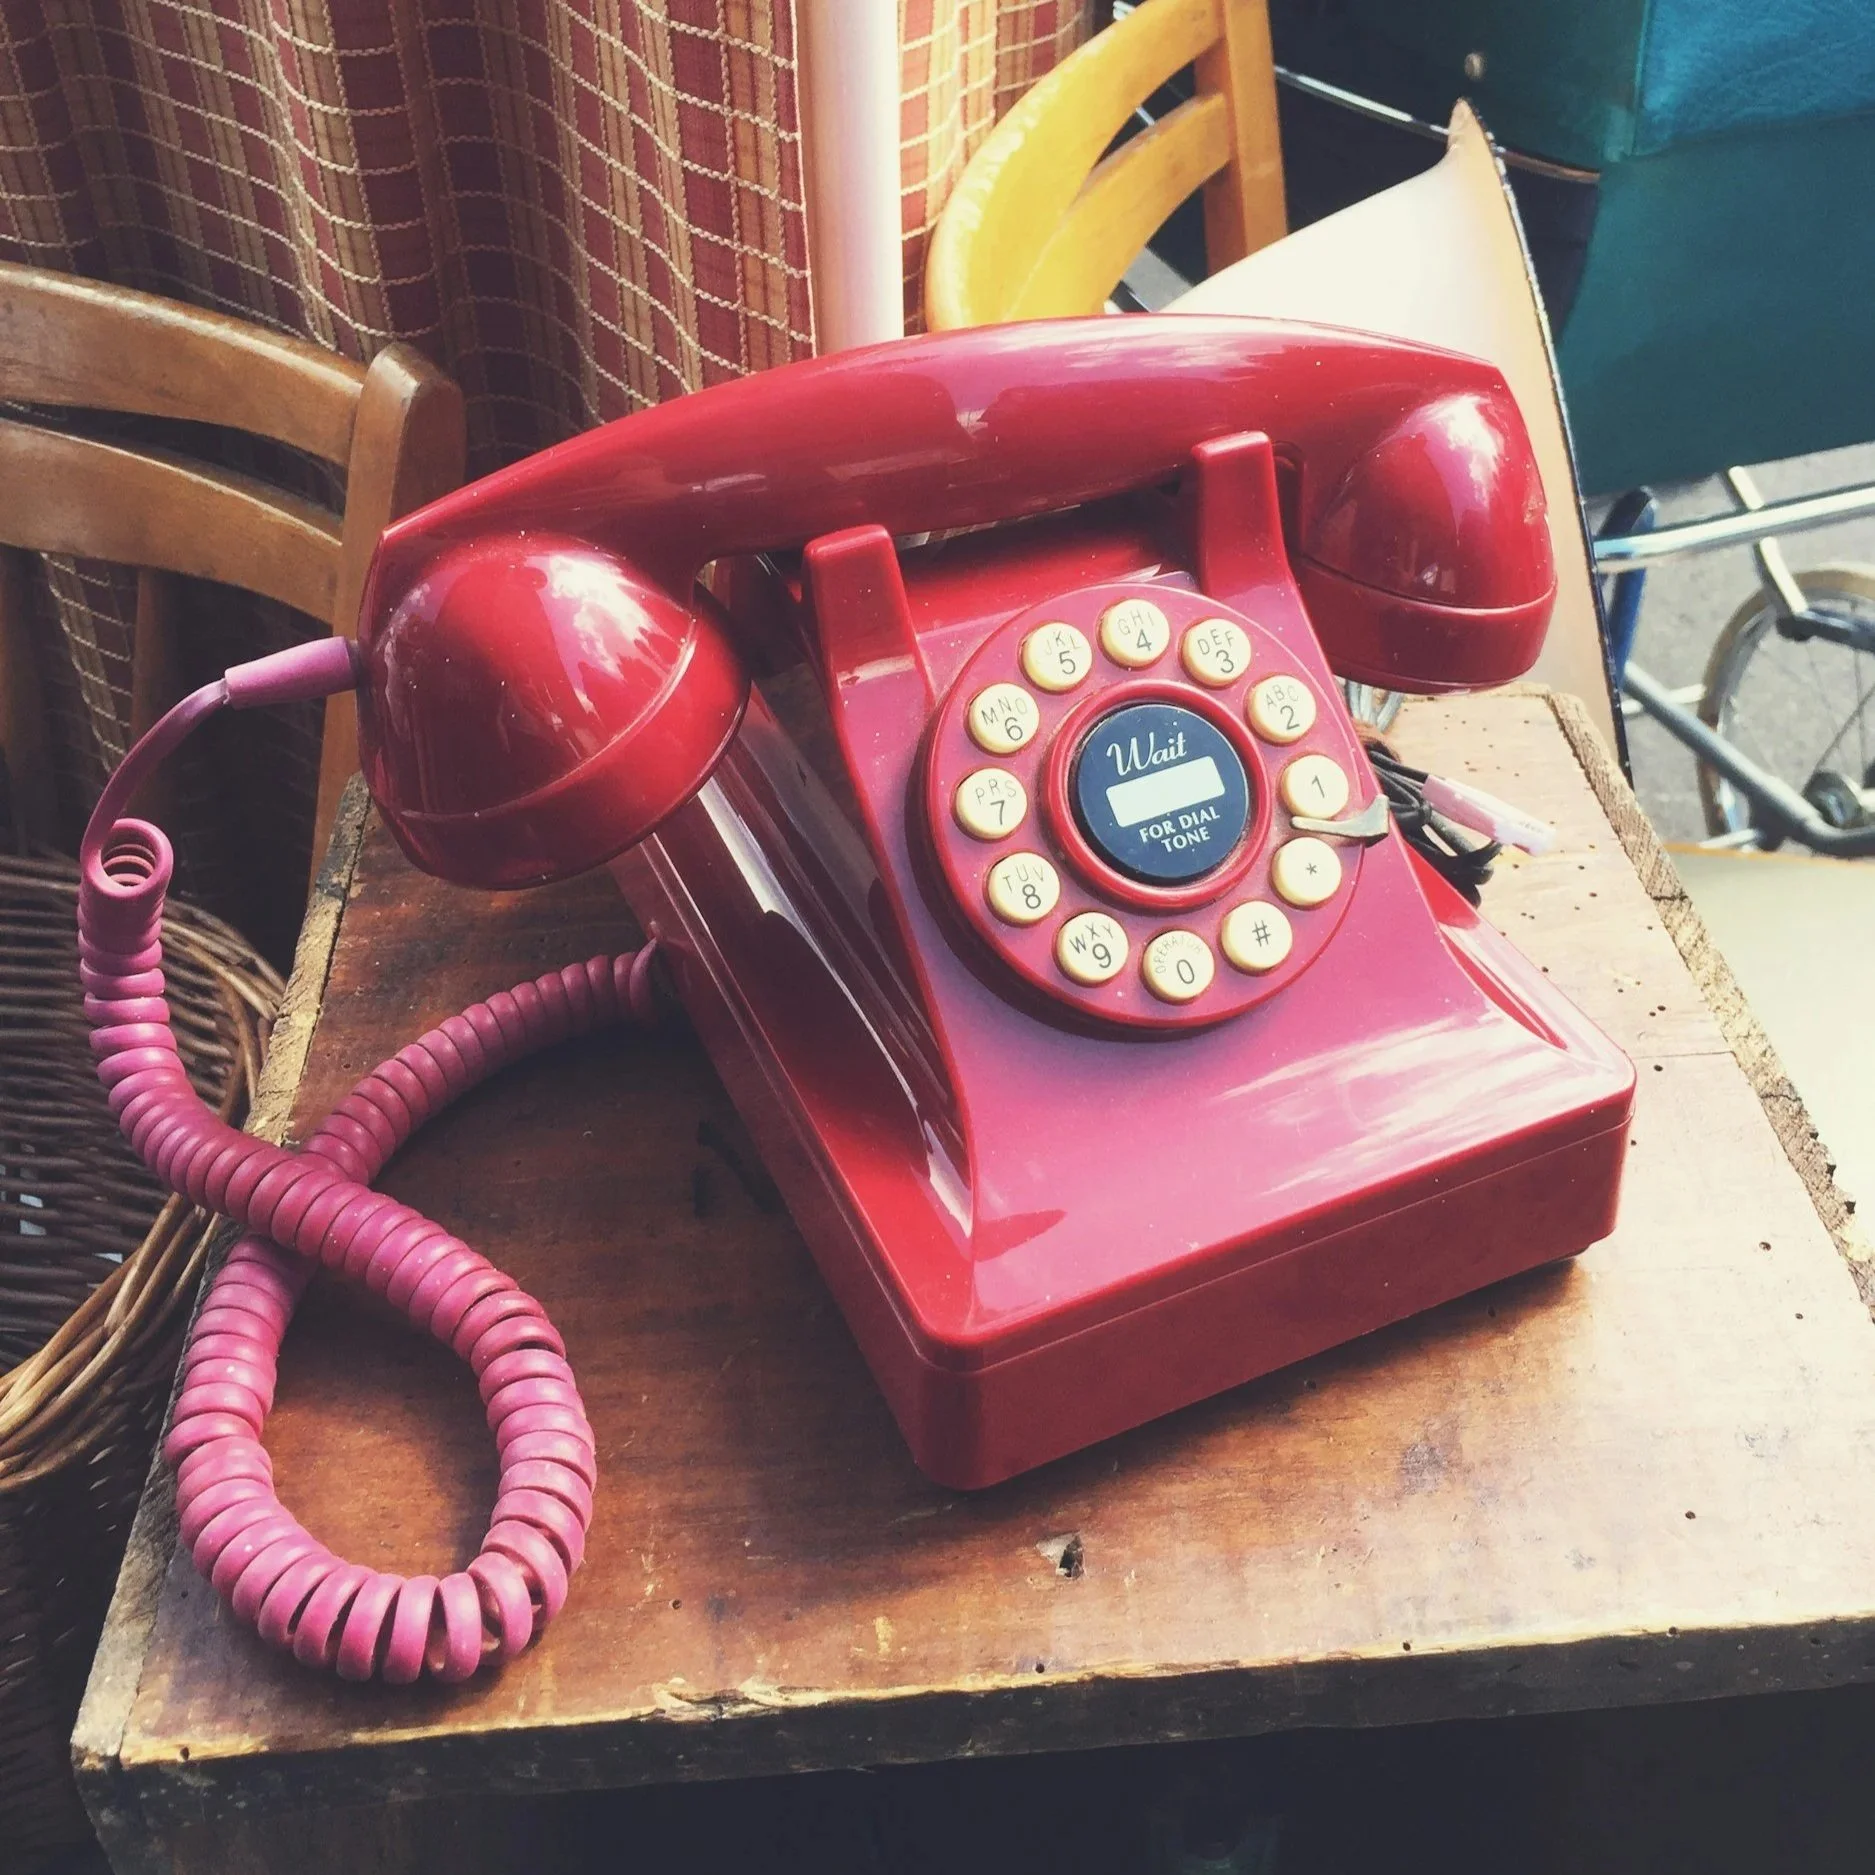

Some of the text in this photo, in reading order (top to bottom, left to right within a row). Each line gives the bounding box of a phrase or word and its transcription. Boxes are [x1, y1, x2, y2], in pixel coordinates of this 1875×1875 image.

[1136, 629, 1152, 653] 4
[1198, 628, 1235, 656] DEF
[1058, 650, 1075, 675] 5
[1216, 650, 1234, 674] 3
[1265, 684, 1298, 711] ABC
[981, 697, 1026, 725] MNO
[1281, 705, 1300, 730] 2
[1005, 716, 1023, 742] 6
[1106, 732, 1187, 776] Wait
[975, 778, 1016, 805] PRS
[1311, 776, 1325, 798] 1
[990, 800, 1005, 826] 7
[1139, 806, 1220, 843] FOR DIAL
[1161, 826, 1210, 853] TONE
[1003, 866, 1045, 892] TUV
[1022, 883, 1041, 910] 8
[1069, 923, 1114, 954] WXY
[1252, 921, 1270, 947] #
[1092, 943, 1112, 968] 9
[1177, 959, 1195, 985] 0
